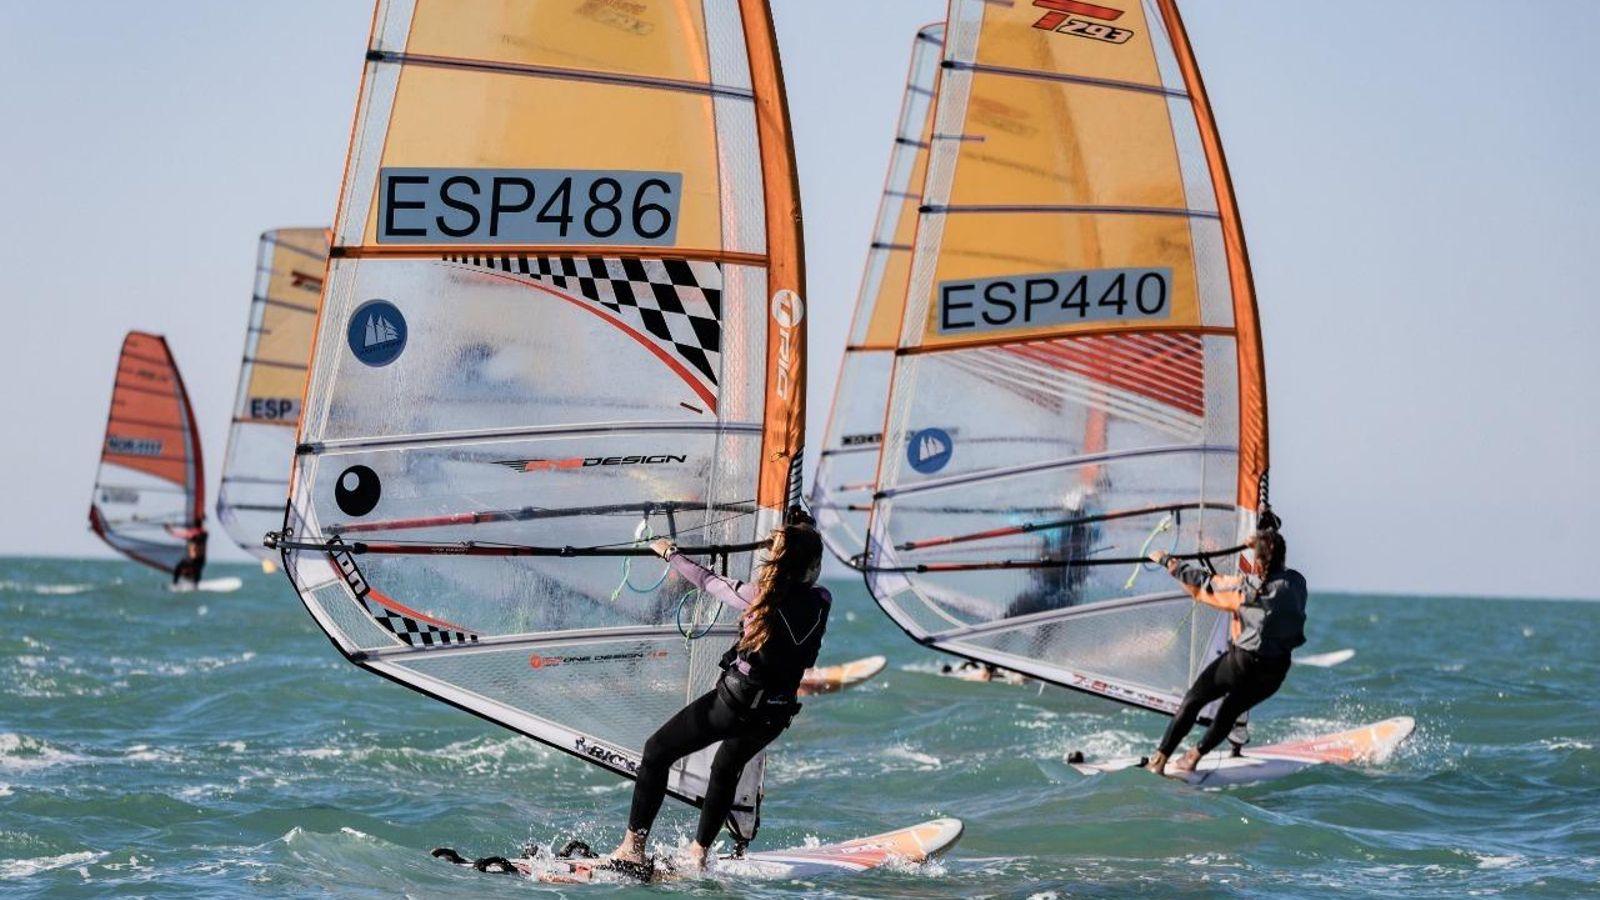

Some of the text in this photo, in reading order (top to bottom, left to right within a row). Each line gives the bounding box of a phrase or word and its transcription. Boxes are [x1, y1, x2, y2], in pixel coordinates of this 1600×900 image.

[384, 175, 672, 239] ESP486
[942, 272, 1166, 330] ESP440
[251, 399, 293, 419] ESP
[582, 454, 687, 467] DESIGN
